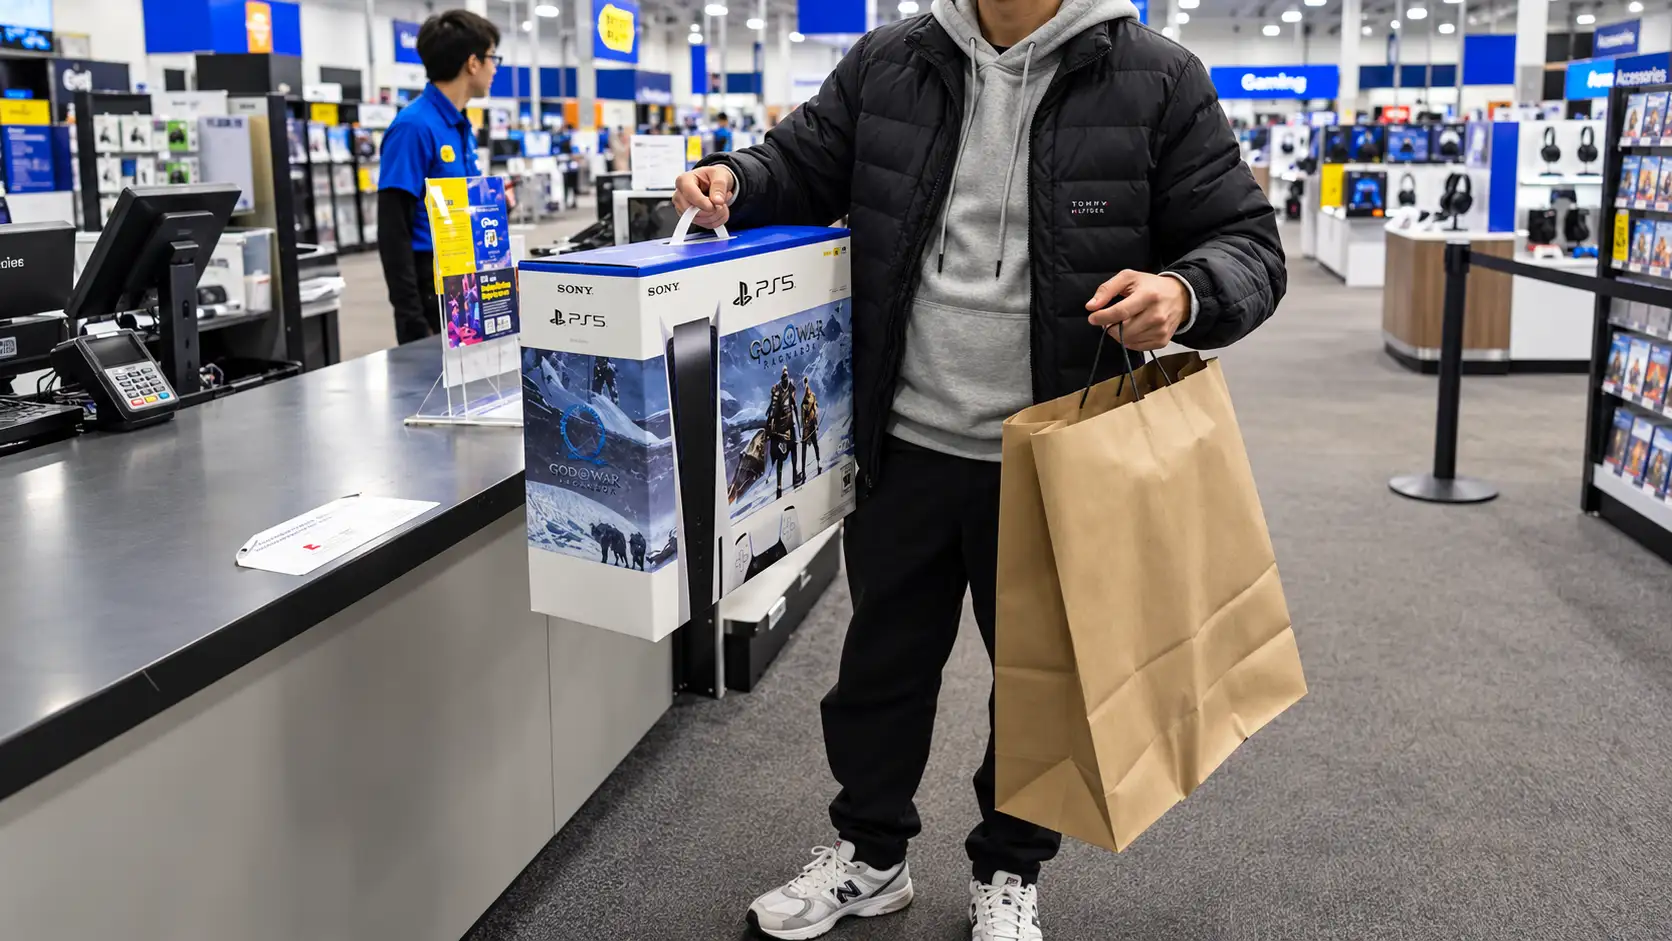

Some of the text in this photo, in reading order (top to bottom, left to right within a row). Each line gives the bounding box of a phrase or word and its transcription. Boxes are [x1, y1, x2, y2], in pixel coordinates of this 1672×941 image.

[1241, 72, 1307, 94] Gaming
[1616, 66, 1667, 86] Accessories
[557, 284, 594, 295] SONY
[647, 282, 680, 297] SONY
[756, 274, 795, 298] PS5
[568, 312, 606, 328] PS5
[749, 319, 825, 364] GOD WAR
[549, 463, 578, 477] GOD
[590, 469, 622, 489] WAR
